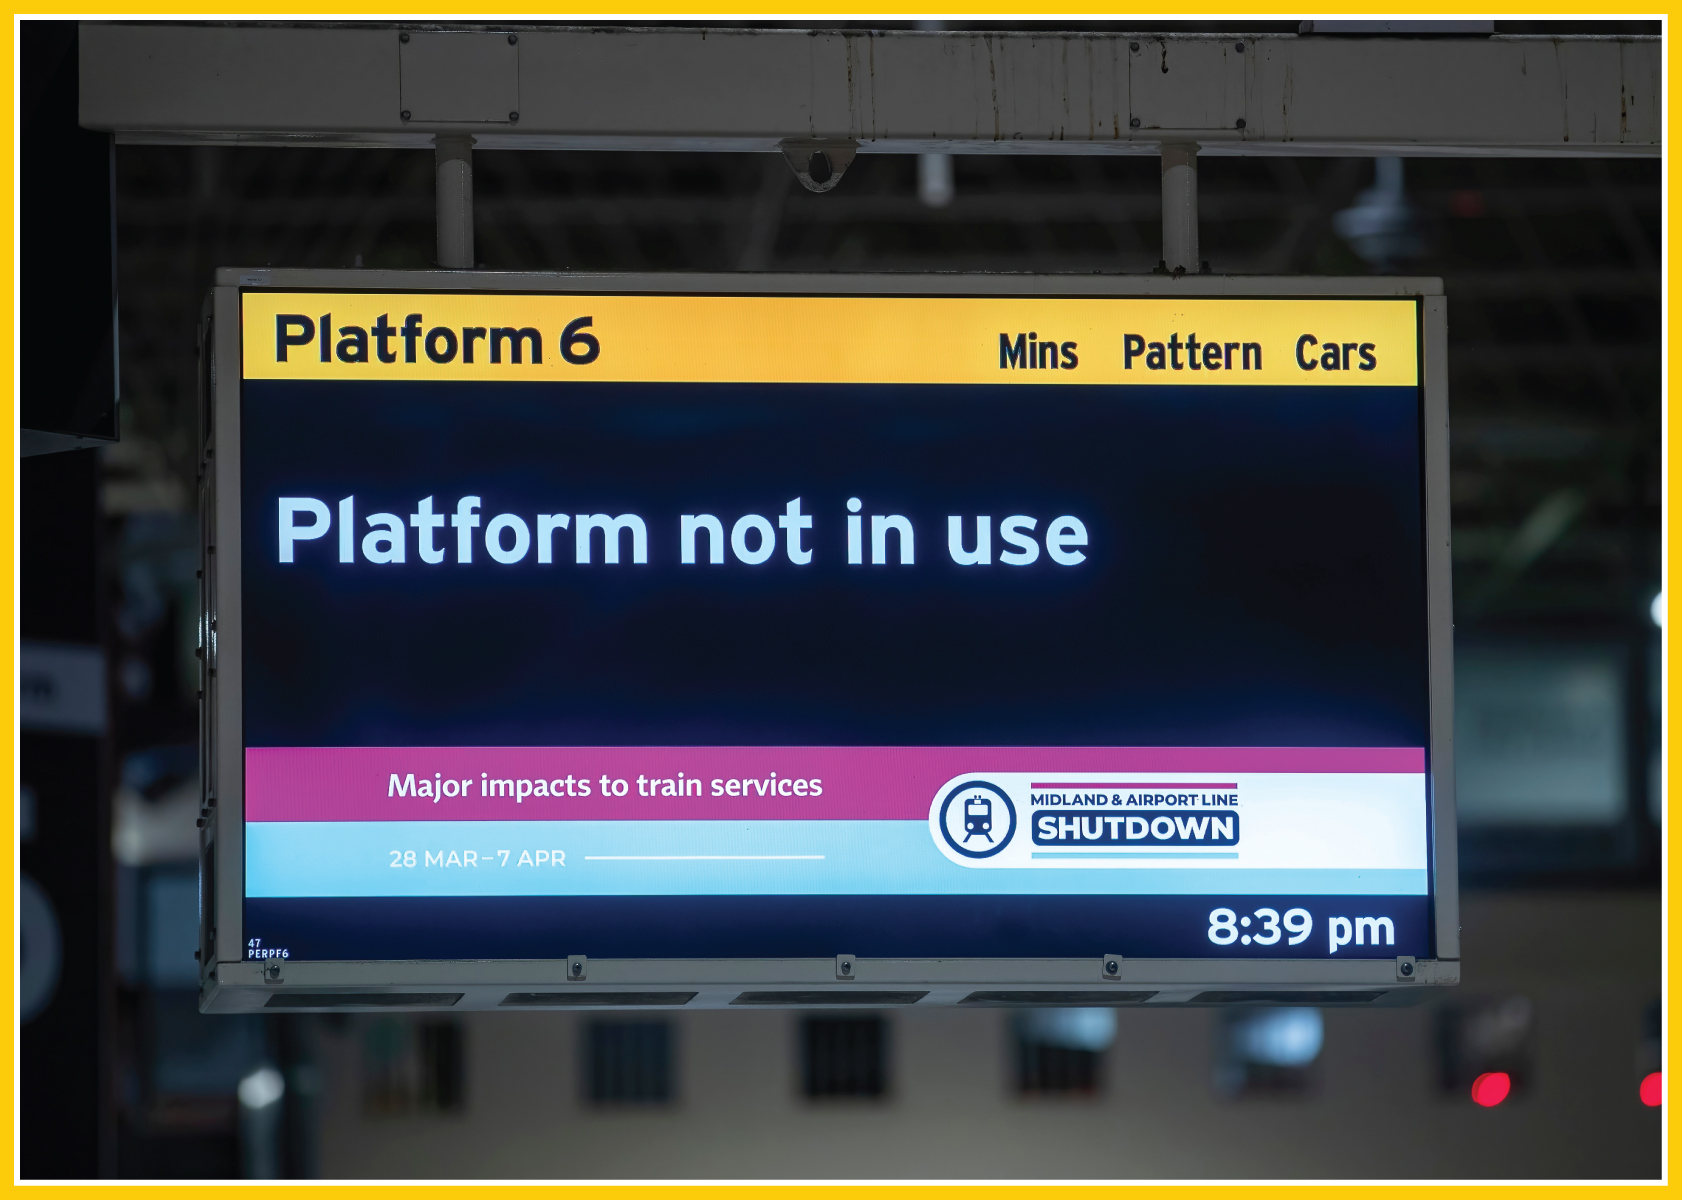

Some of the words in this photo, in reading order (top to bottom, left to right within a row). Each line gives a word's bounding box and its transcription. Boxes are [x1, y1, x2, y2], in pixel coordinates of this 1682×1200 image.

[275, 312, 543, 365] Platform
[559, 315, 601, 365] 6
[999, 331, 1079, 370] Mins
[1123, 332, 1263, 371] Pattern
[1295, 333, 1377, 371] Cars
[278, 495, 648, 565] Platform
[680, 496, 813, 566] not
[846, 497, 915, 565] in
[947, 514, 1089, 566] use
[387, 772, 473, 804] Major
[480, 772, 592, 804] impacts
[598, 774, 629, 797] to
[635, 772, 702, 797] train
[710, 771, 823, 797] services
[1030, 793, 1109, 806] MIDLAND
[1111, 793, 1123, 806] &
[1125, 793, 1199, 806] AIRPORT
[1201, 794, 1239, 806] LINE
[1037, 815, 1235, 841] SHUTDOWN
[389, 850, 417, 868] 28
[516, 849, 566, 868] APR
[248, 938, 261, 948] 47
[1207, 907, 1313, 946] 8:39
[1328, 916, 1395, 955] pm
[248, 948, 289, 959] PERPF6
